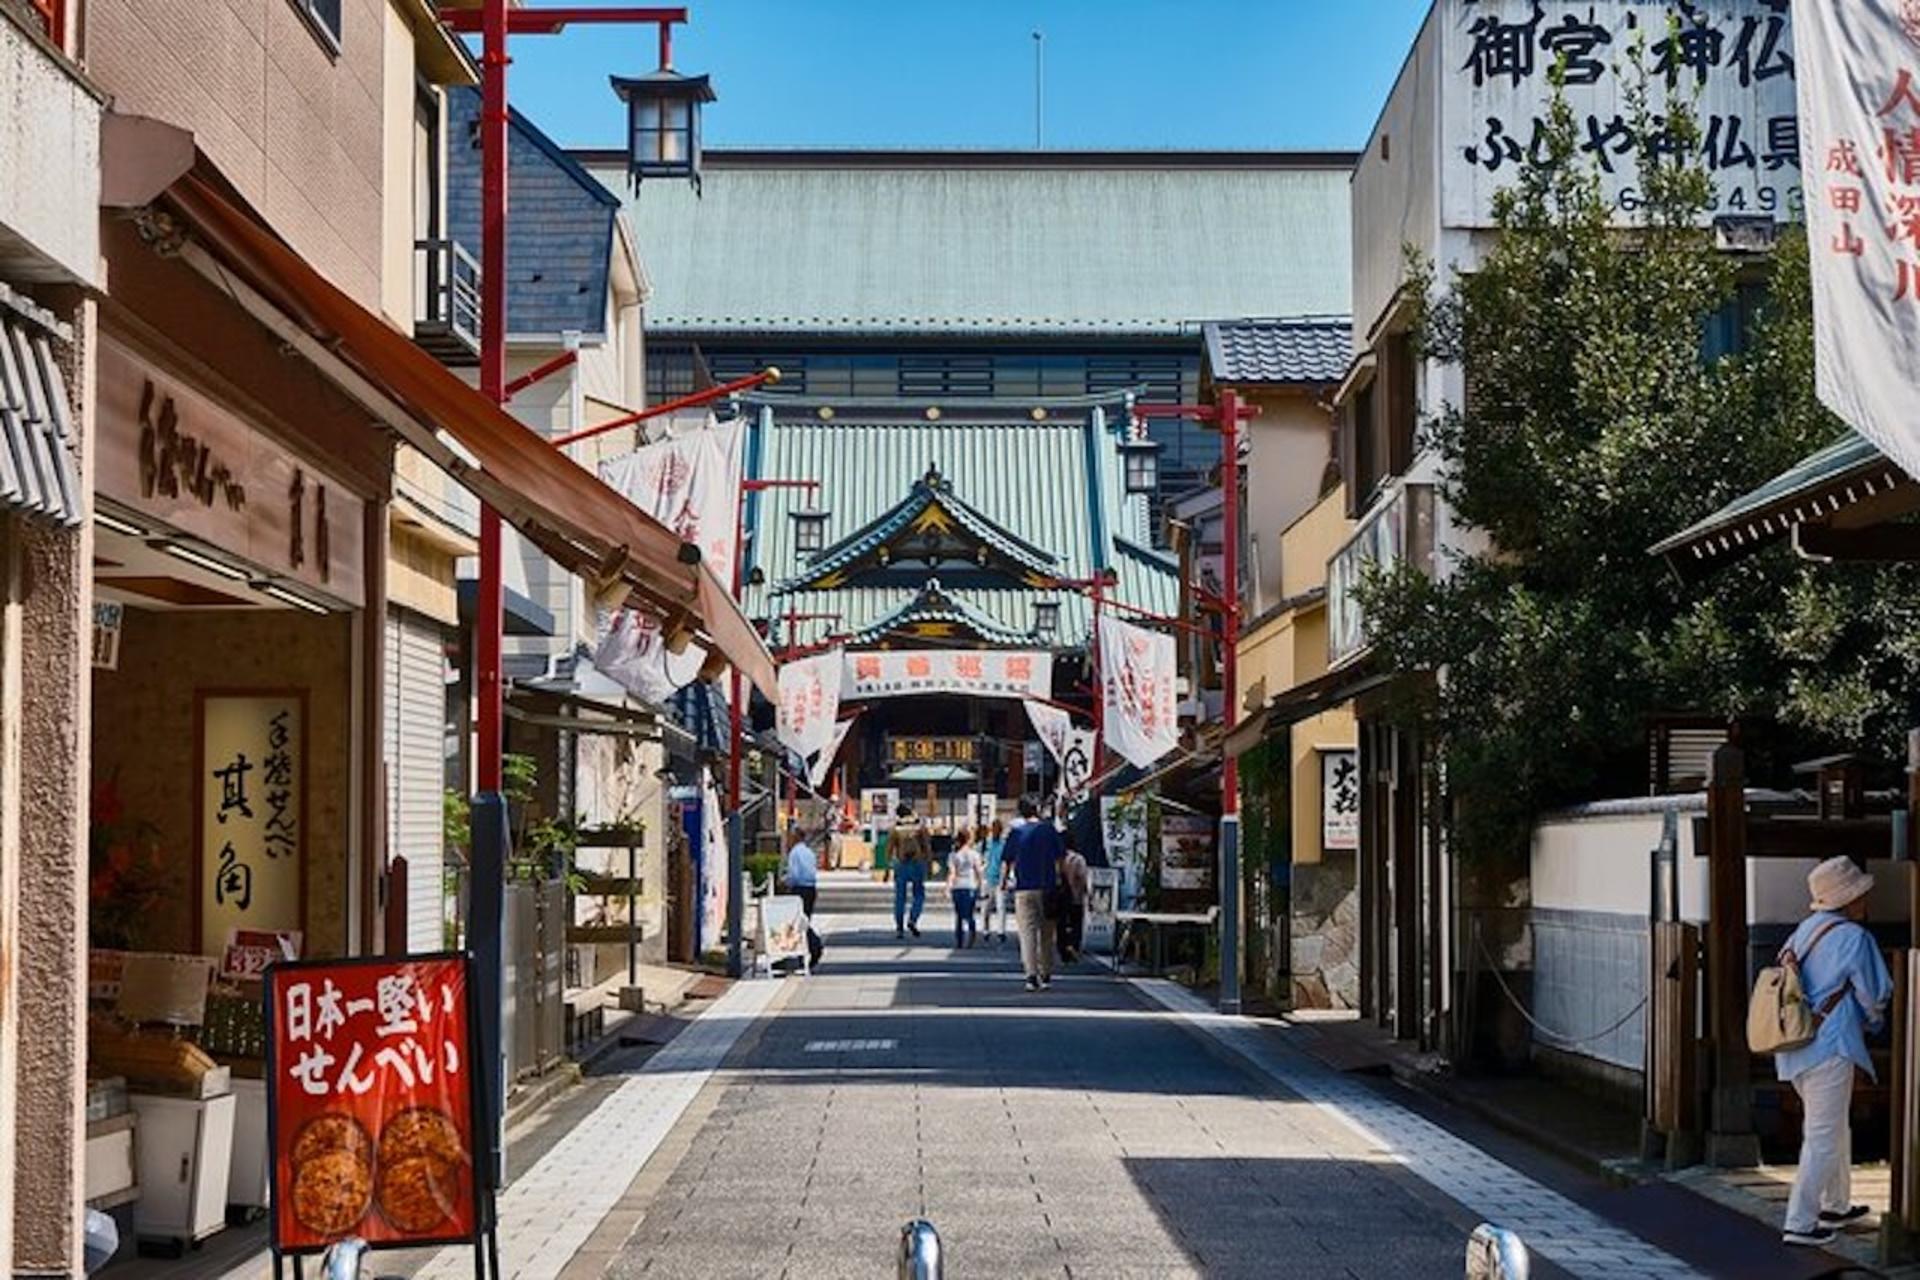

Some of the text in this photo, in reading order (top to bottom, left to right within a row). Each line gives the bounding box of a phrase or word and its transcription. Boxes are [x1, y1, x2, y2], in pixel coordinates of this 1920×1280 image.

[1826, 138, 1864, 258] 成田山
[213, 753, 253, 911] 其角
[286, 975, 455, 1042] 日本一堅い
[289, 1037, 459, 1095] せんべい
